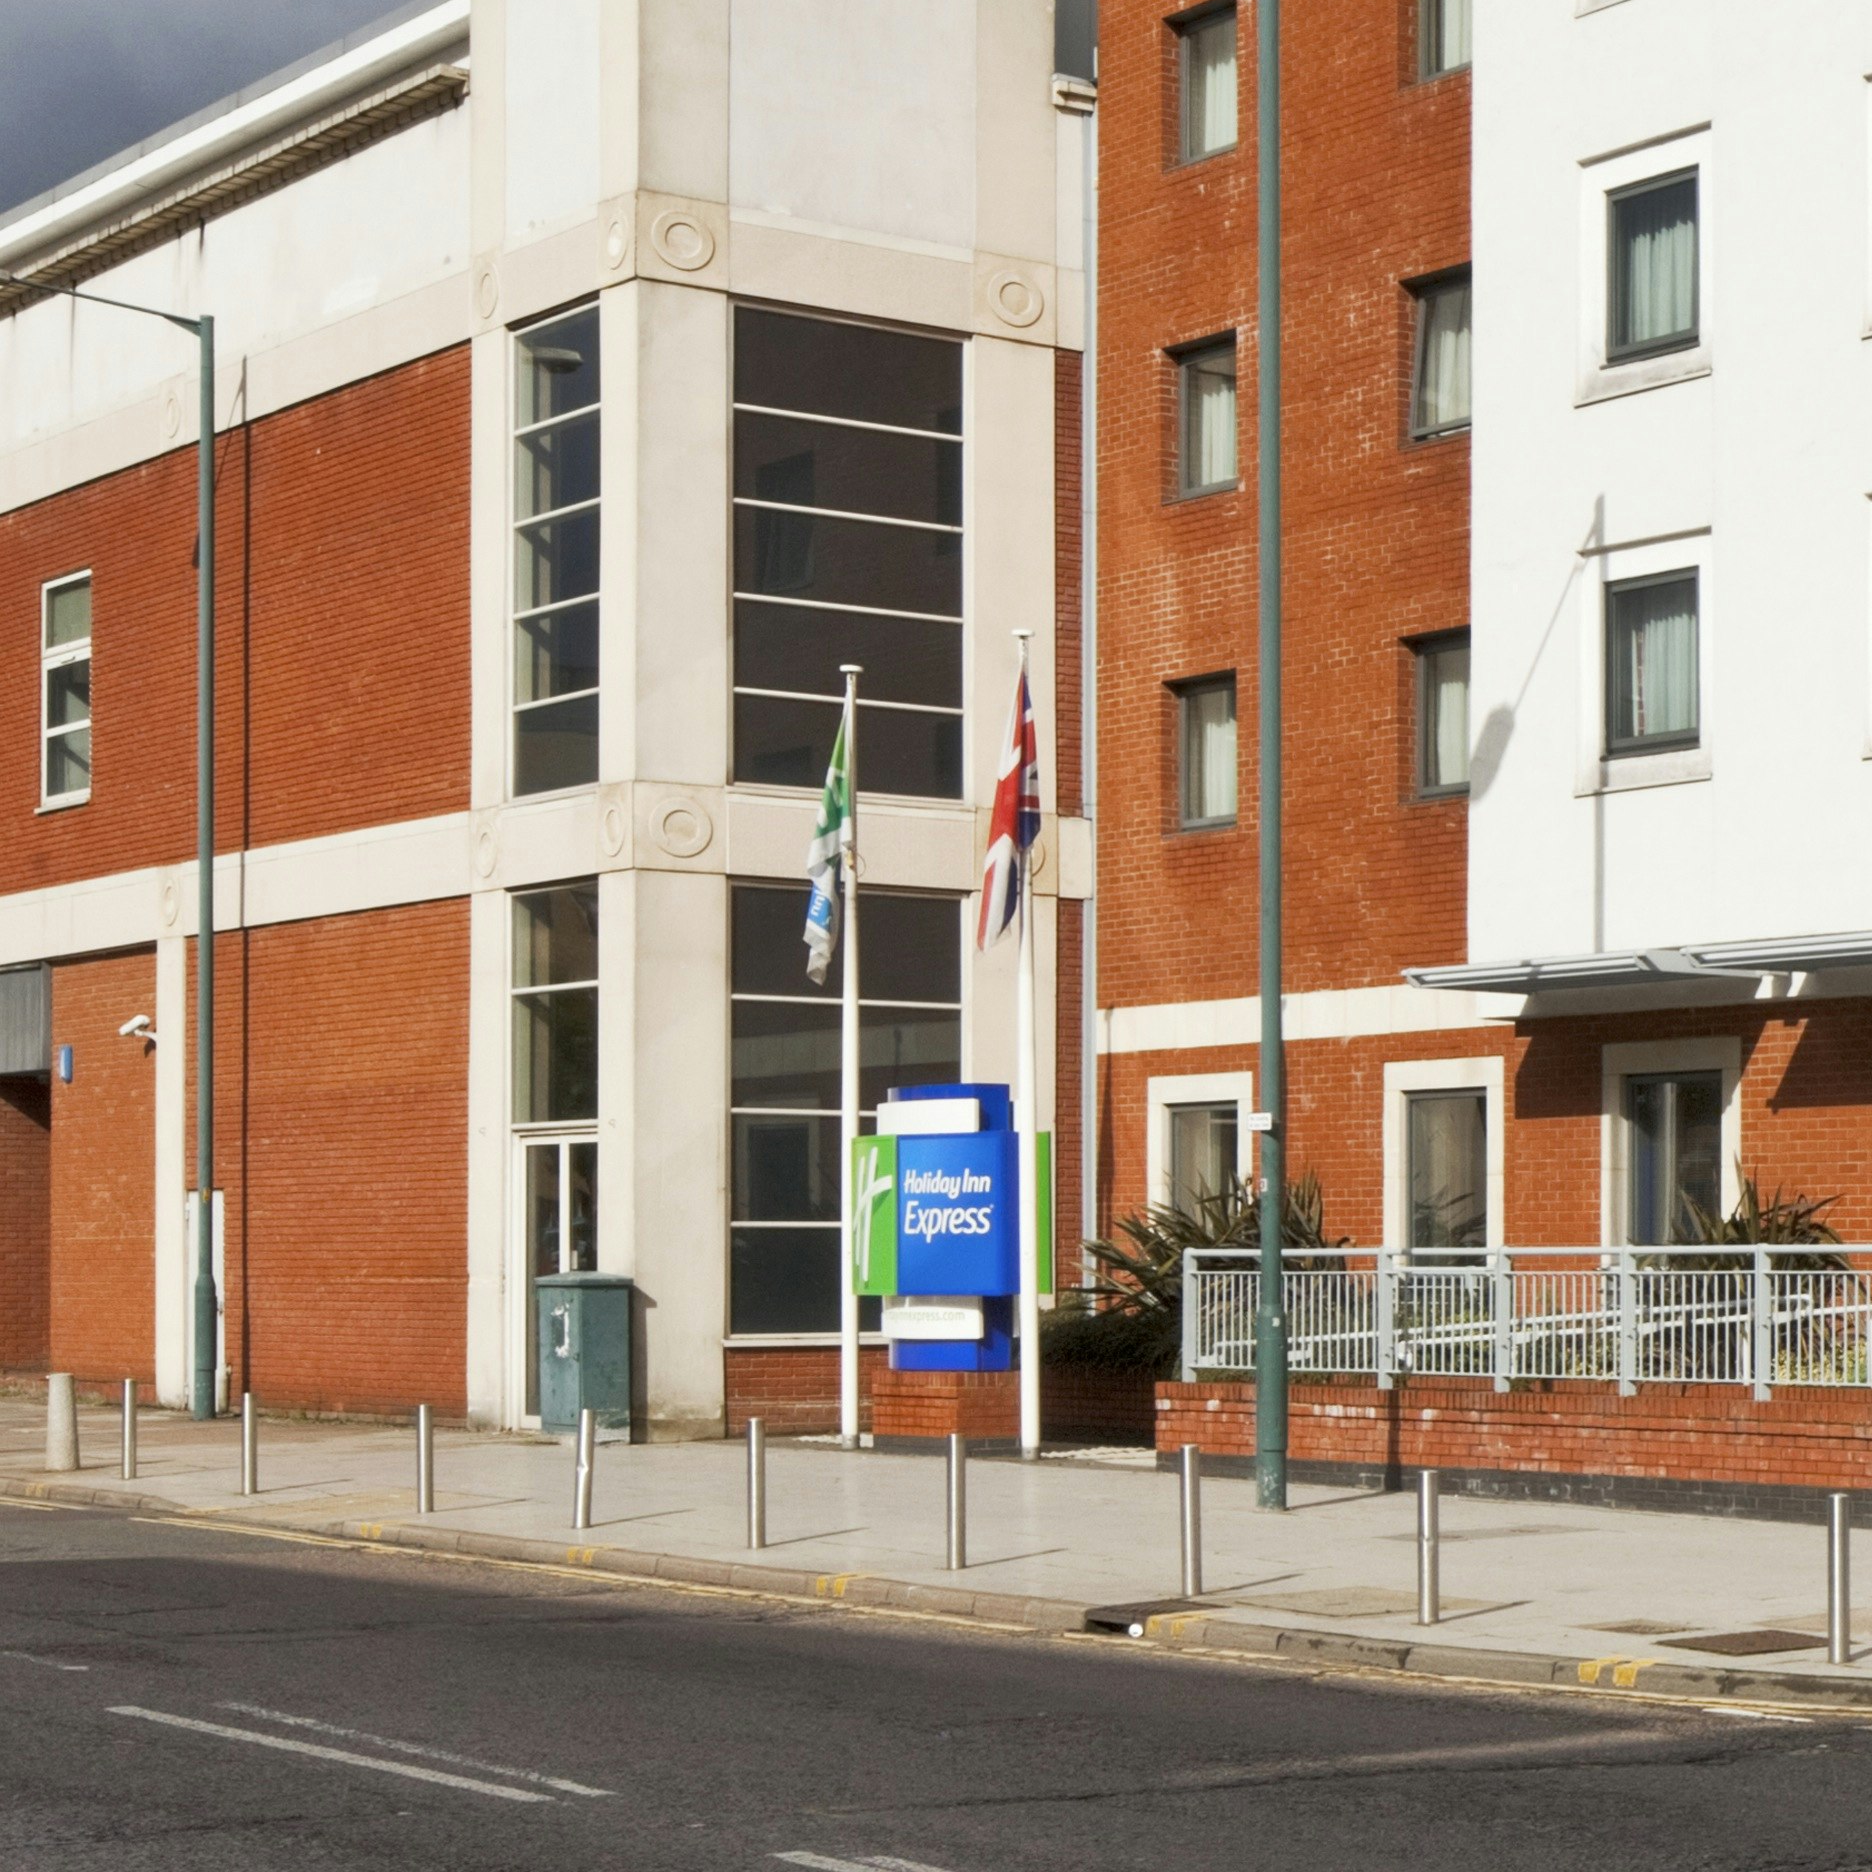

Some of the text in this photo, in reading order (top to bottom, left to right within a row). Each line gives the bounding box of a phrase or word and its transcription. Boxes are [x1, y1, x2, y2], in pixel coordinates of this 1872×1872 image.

[903, 1168, 991, 1199] Holiday Inn
[904, 1200, 992, 1244] Express
